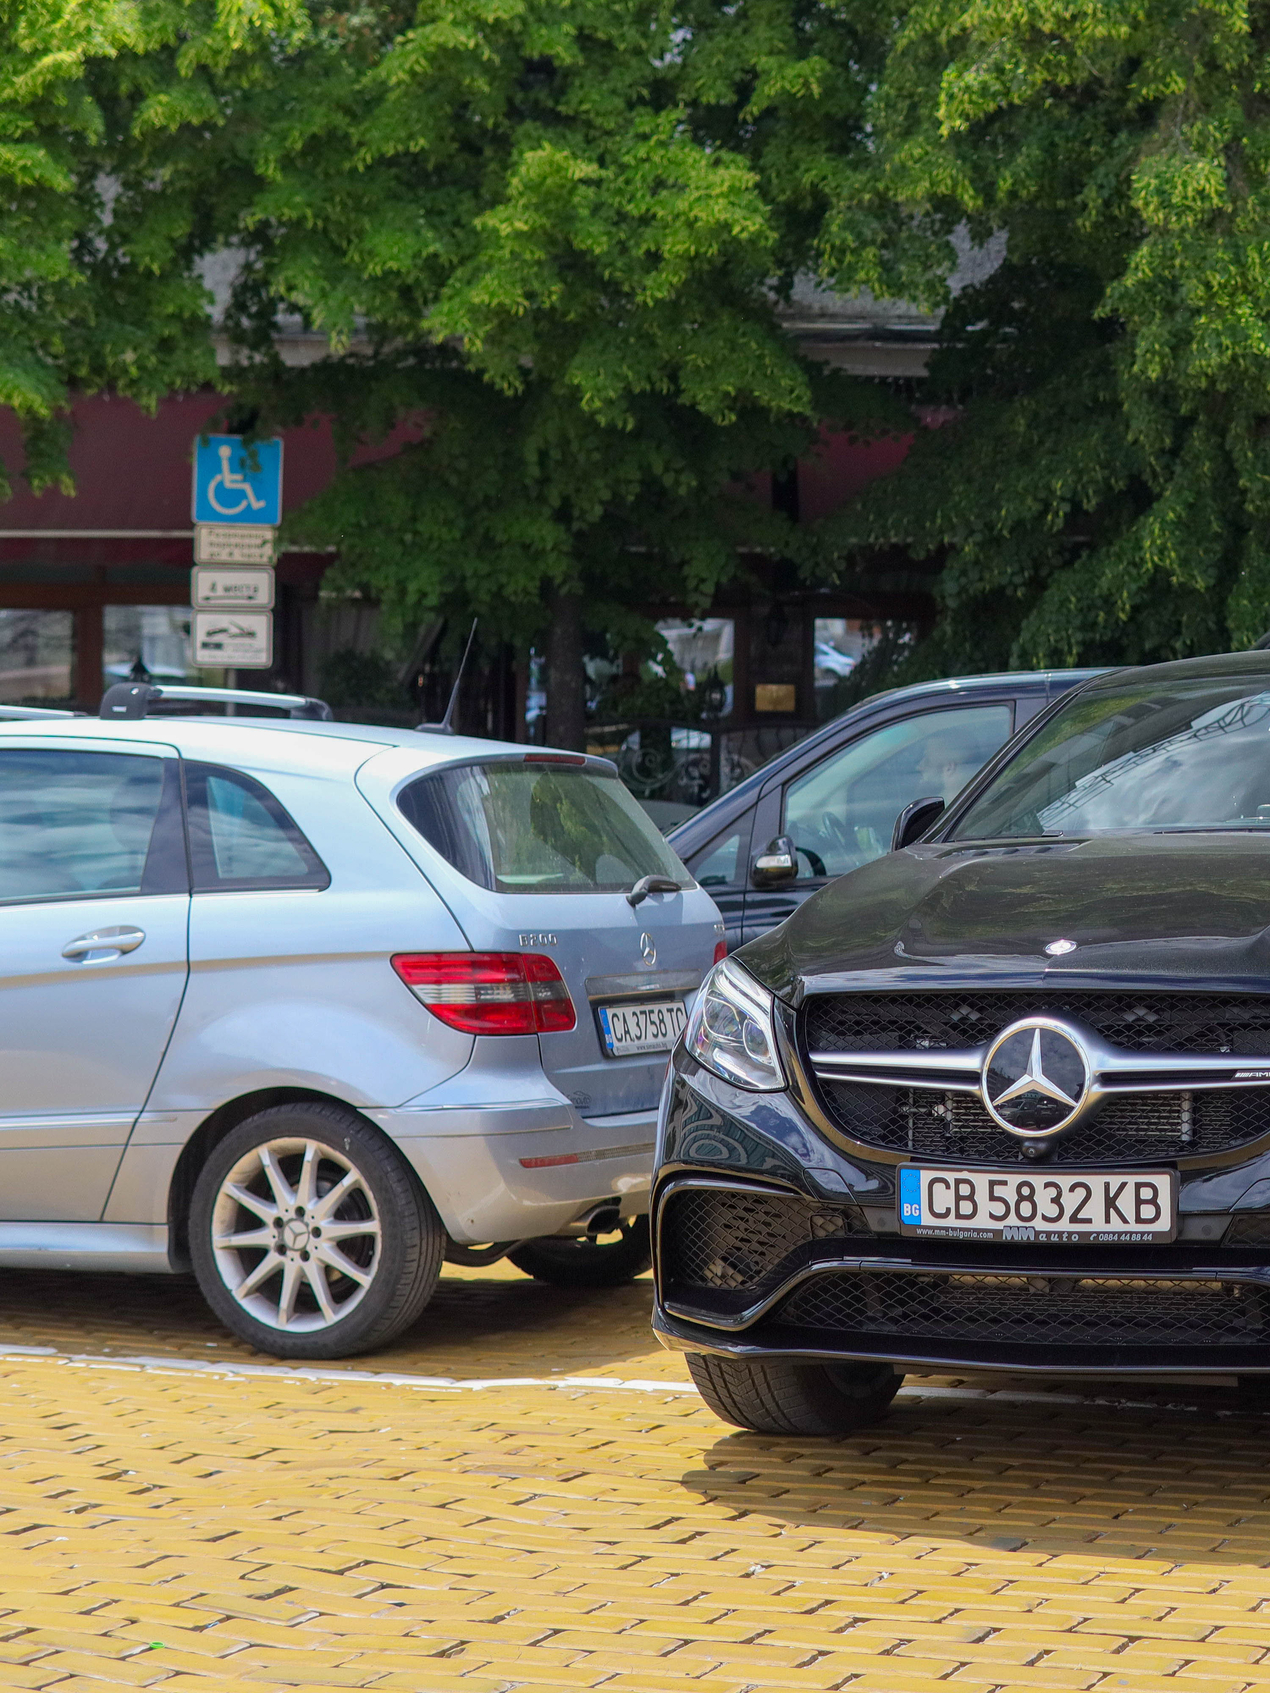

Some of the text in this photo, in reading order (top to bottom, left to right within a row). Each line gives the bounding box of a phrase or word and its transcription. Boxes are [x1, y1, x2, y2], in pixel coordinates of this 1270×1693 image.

[611, 1012, 633, 1042] CA
[632, 1009, 668, 1040] 3758
[903, 1203, 920, 1216] BG
[927, 1176, 1162, 1225] CB 5832 KB
[916, 1227, 994, 1239] www.mm-bulgaria.com
[1002, 1226, 1035, 1241] MM
[1098, 1233, 1118, 1242] 0884
[1119, 1233, 1131, 1242] 44
[1131, 1233, 1142, 1242] 88
[1142, 1233, 1153, 1242] 44
